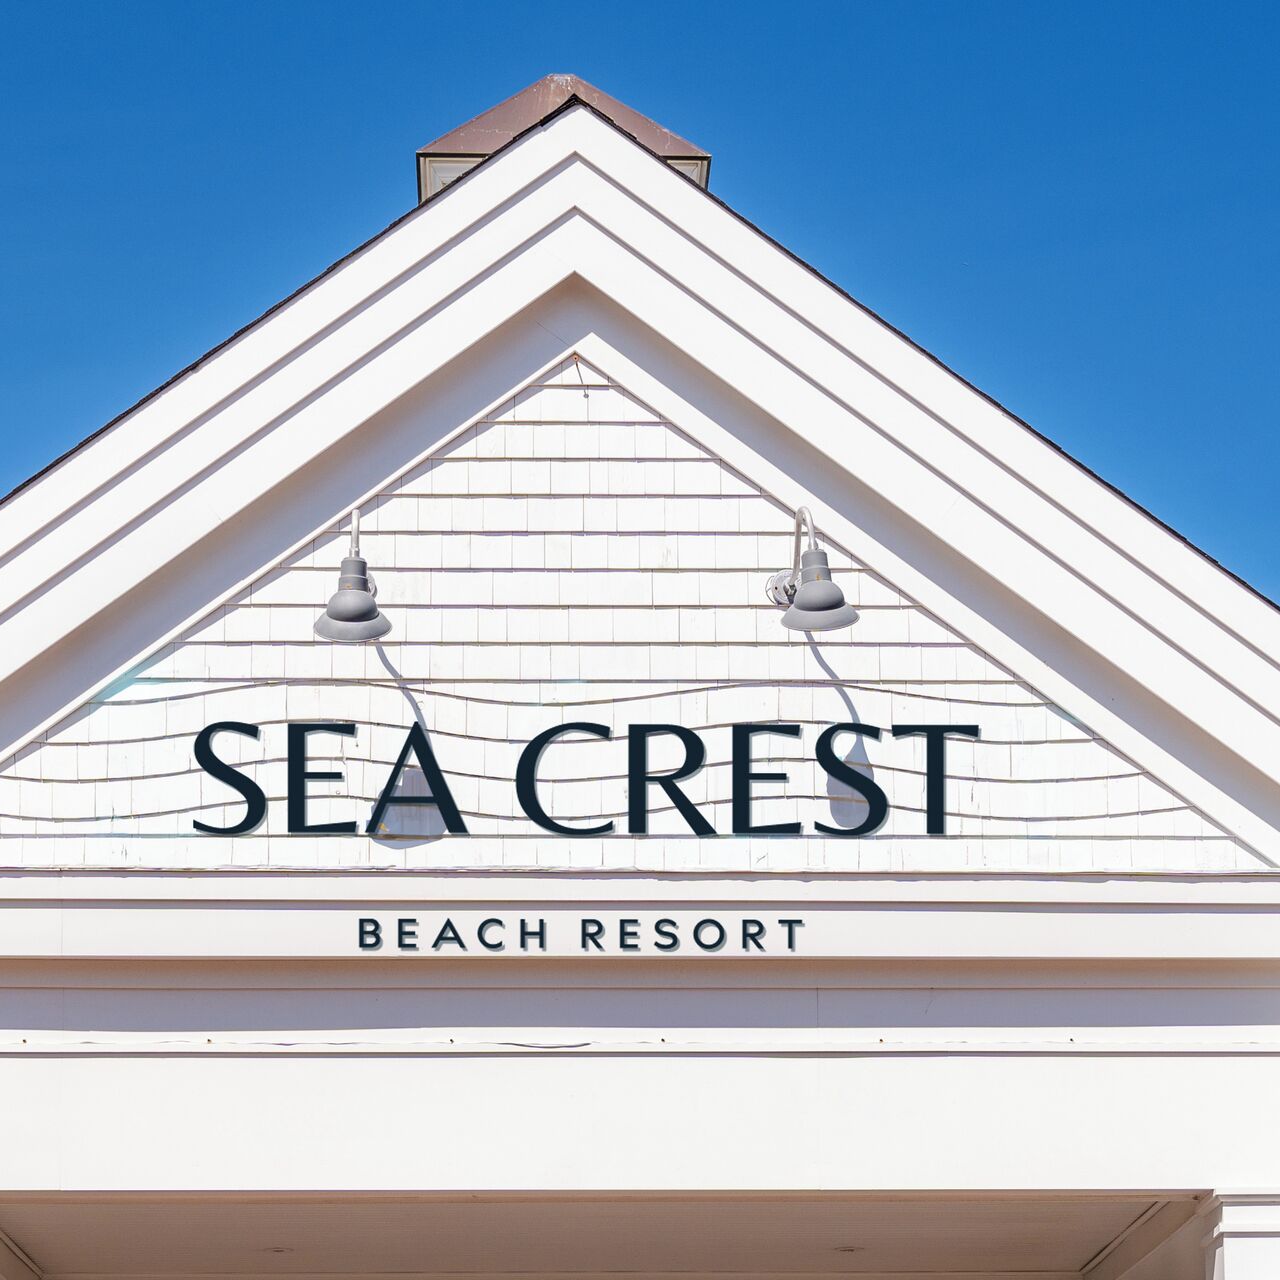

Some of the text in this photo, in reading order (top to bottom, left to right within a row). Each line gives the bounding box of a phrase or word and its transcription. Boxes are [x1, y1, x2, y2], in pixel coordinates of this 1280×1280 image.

[193, 721, 980, 839] SEA CREST
[358, 918, 805, 951] BEACH RESORT
